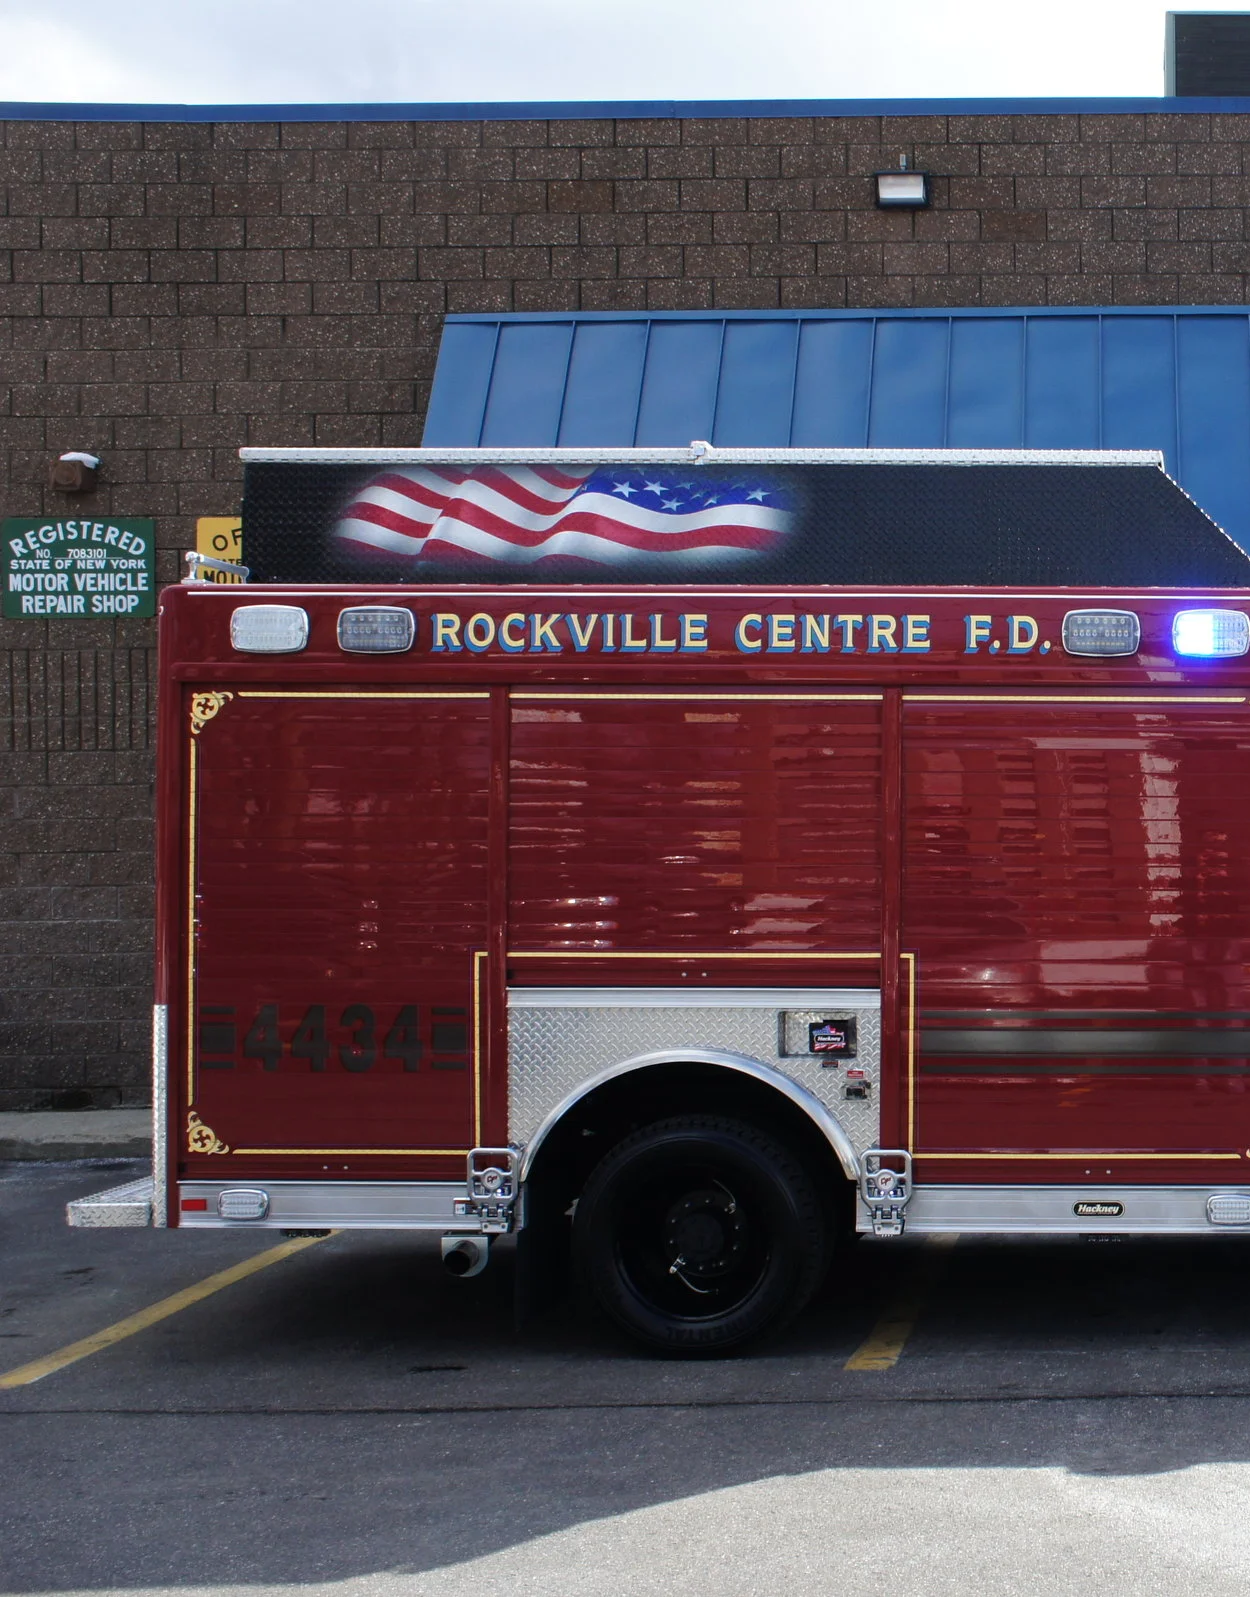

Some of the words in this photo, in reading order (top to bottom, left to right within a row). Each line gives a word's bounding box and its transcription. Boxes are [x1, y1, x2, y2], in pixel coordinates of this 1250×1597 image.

[9, 521, 146, 557] REGISTERED
[36, 549, 52, 559] NO.
[67, 548, 107, 559] 7083101
[10, 560, 50, 570] STATE
[55, 560, 73, 570] OF
[76, 560, 106, 569] NEW
[110, 560, 146, 569] YORK
[9, 573, 69, 592] MOTOR
[74, 573, 149, 592] VEHICLE
[22, 595, 85, 614] REPAIR
[92, 594, 139, 613] SHOP
[430, 613, 708, 653] ROCKVILLE
[734, 613, 931, 653] CENTRE
[963, 614, 1051, 654] F.D.
[243, 1003, 424, 1073] 4434
[1077, 1204, 1119, 1214] Hackney
